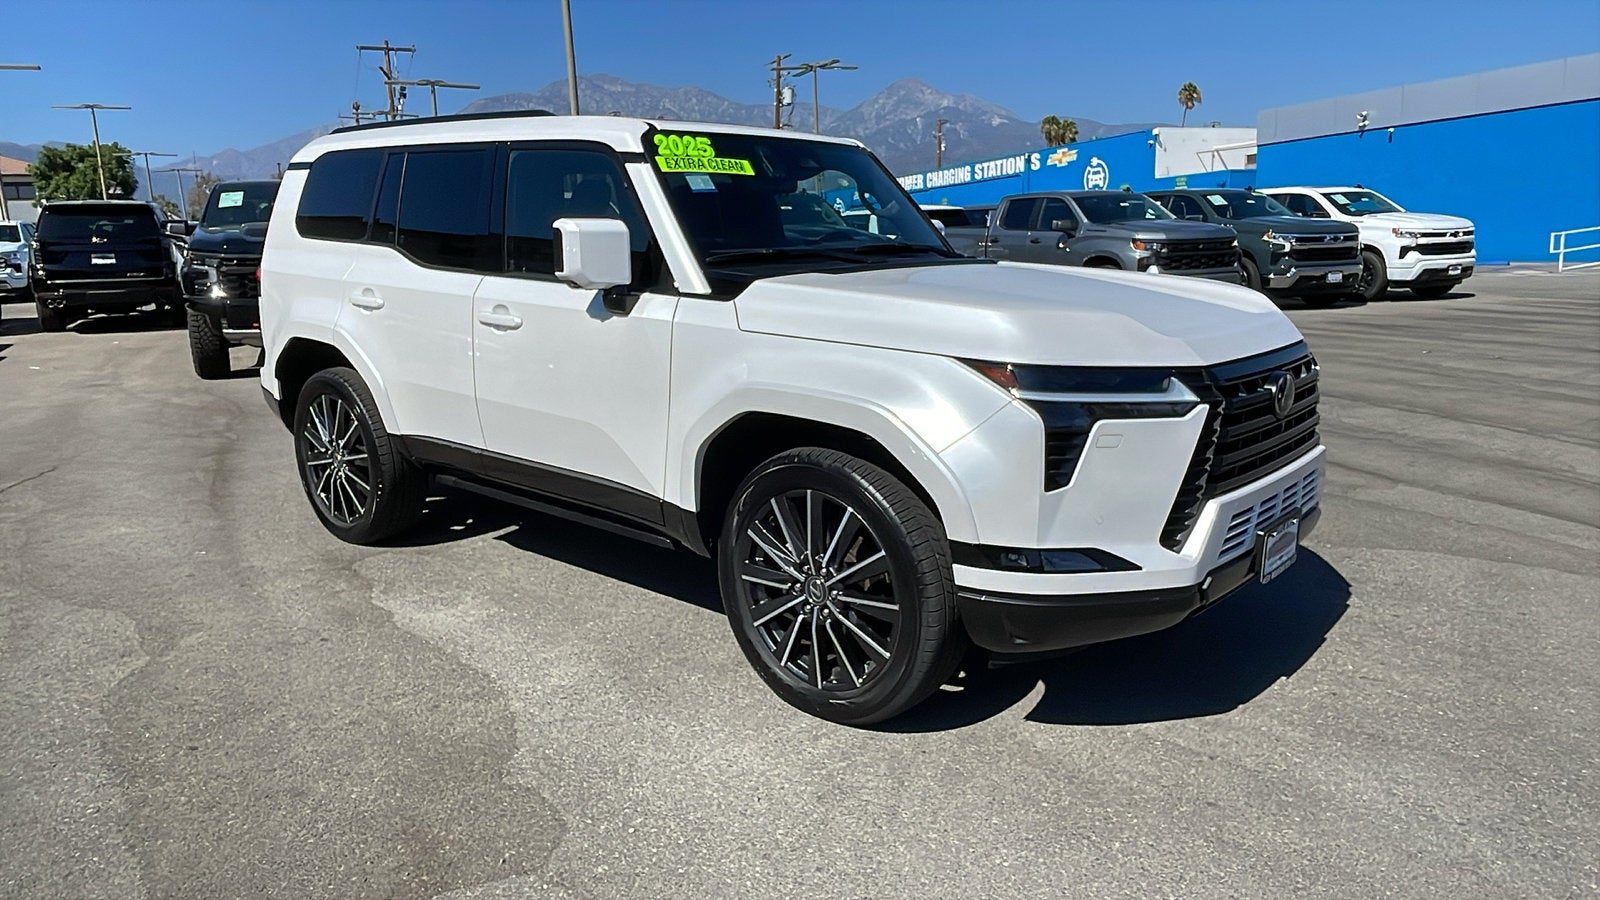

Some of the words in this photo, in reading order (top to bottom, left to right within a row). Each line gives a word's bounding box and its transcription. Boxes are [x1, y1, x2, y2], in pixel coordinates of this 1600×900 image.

[653, 134, 715, 158] 2025
[664, 157, 705, 169] EXTRA
[707, 159, 744, 172] CLEAN
[896, 174, 924, 191] OMER
[926, 165, 971, 188] CHARGING
[974, 152, 1040, 180] STATION'S
